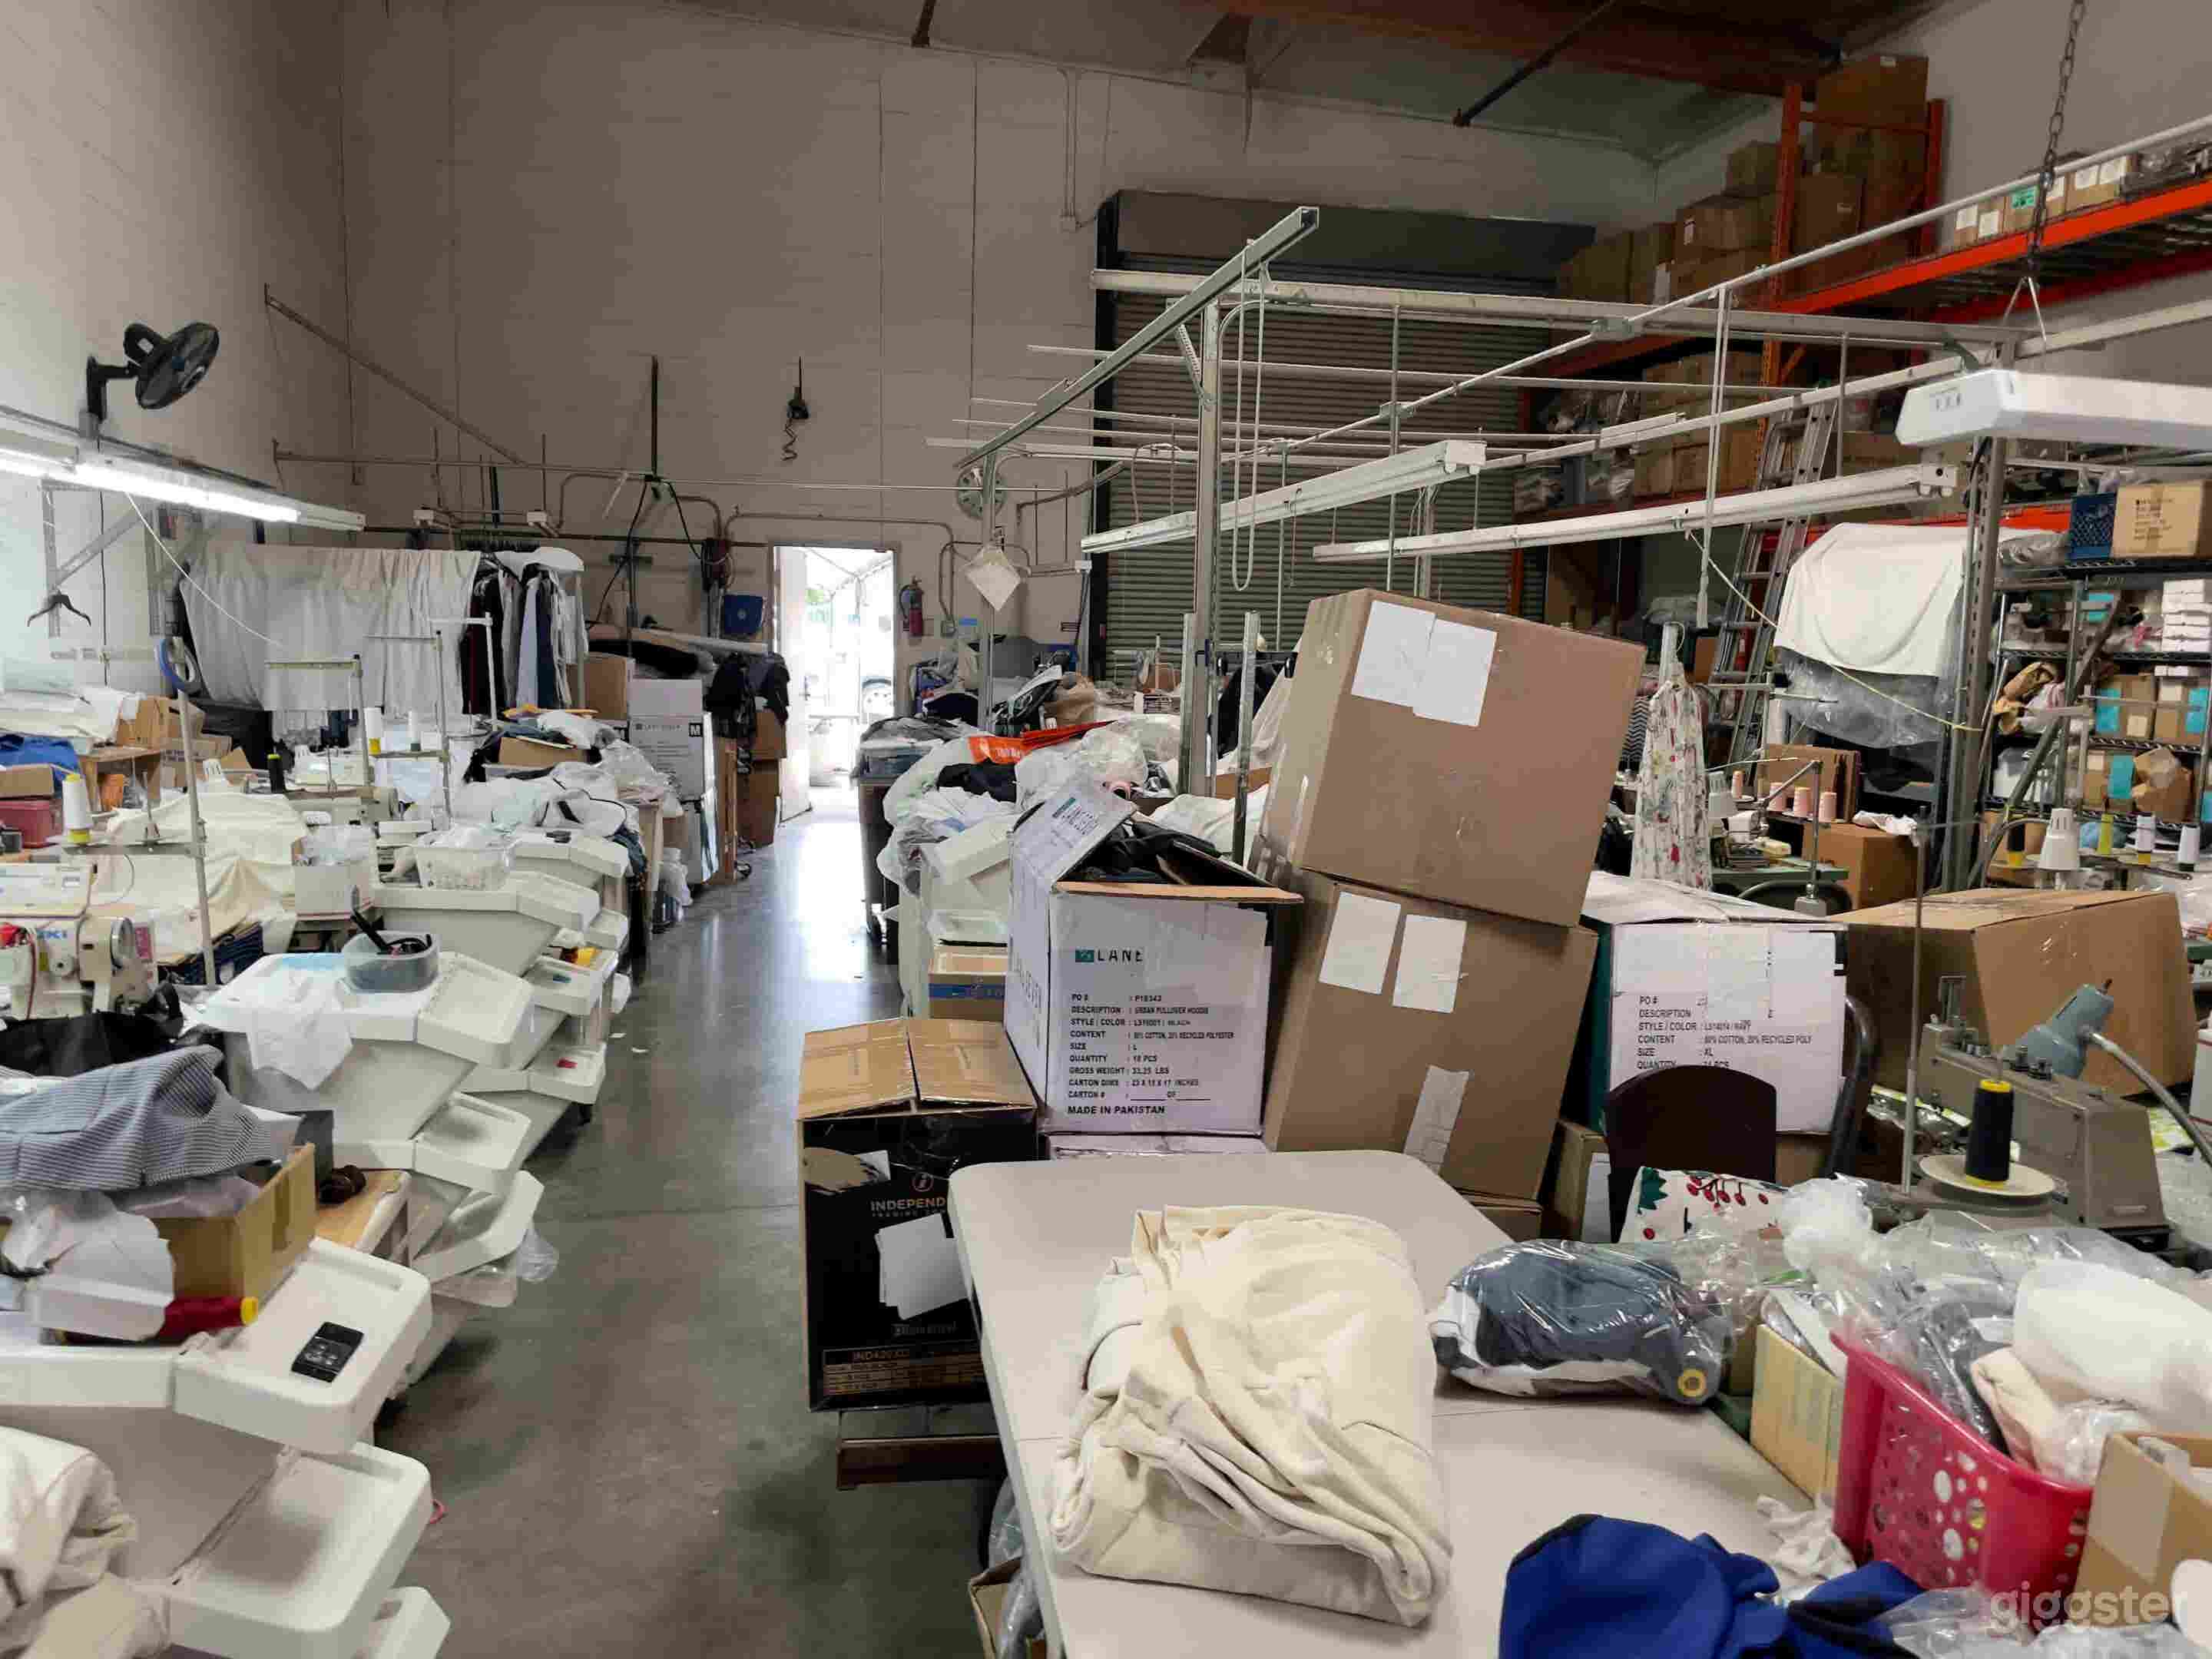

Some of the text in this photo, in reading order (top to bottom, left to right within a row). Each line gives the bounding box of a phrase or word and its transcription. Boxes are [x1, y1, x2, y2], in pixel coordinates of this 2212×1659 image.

[690, 724, 701, 735] M
[1097, 949, 1143, 962] LANE
[1071, 993, 1082, 1002] PO
[1640, 995, 1651, 1005] PO
[1639, 1008, 1691, 1018] DESCRIPTION
[1638, 1022, 1664, 1031] STYLE
[1670, 1022, 1697, 1031] COLOR
[1637, 1035, 1676, 1044] CONTENT
[1069, 1042, 1087, 1051] SIZE
[1637, 1047, 1714, 1056] SIZE XL
[1637, 1060, 1677, 1070] QUANTITY
[1068, 1105, 1165, 1114] MADE IN PAKISTAN
[870, 1196, 947, 1211] INDEPEND
